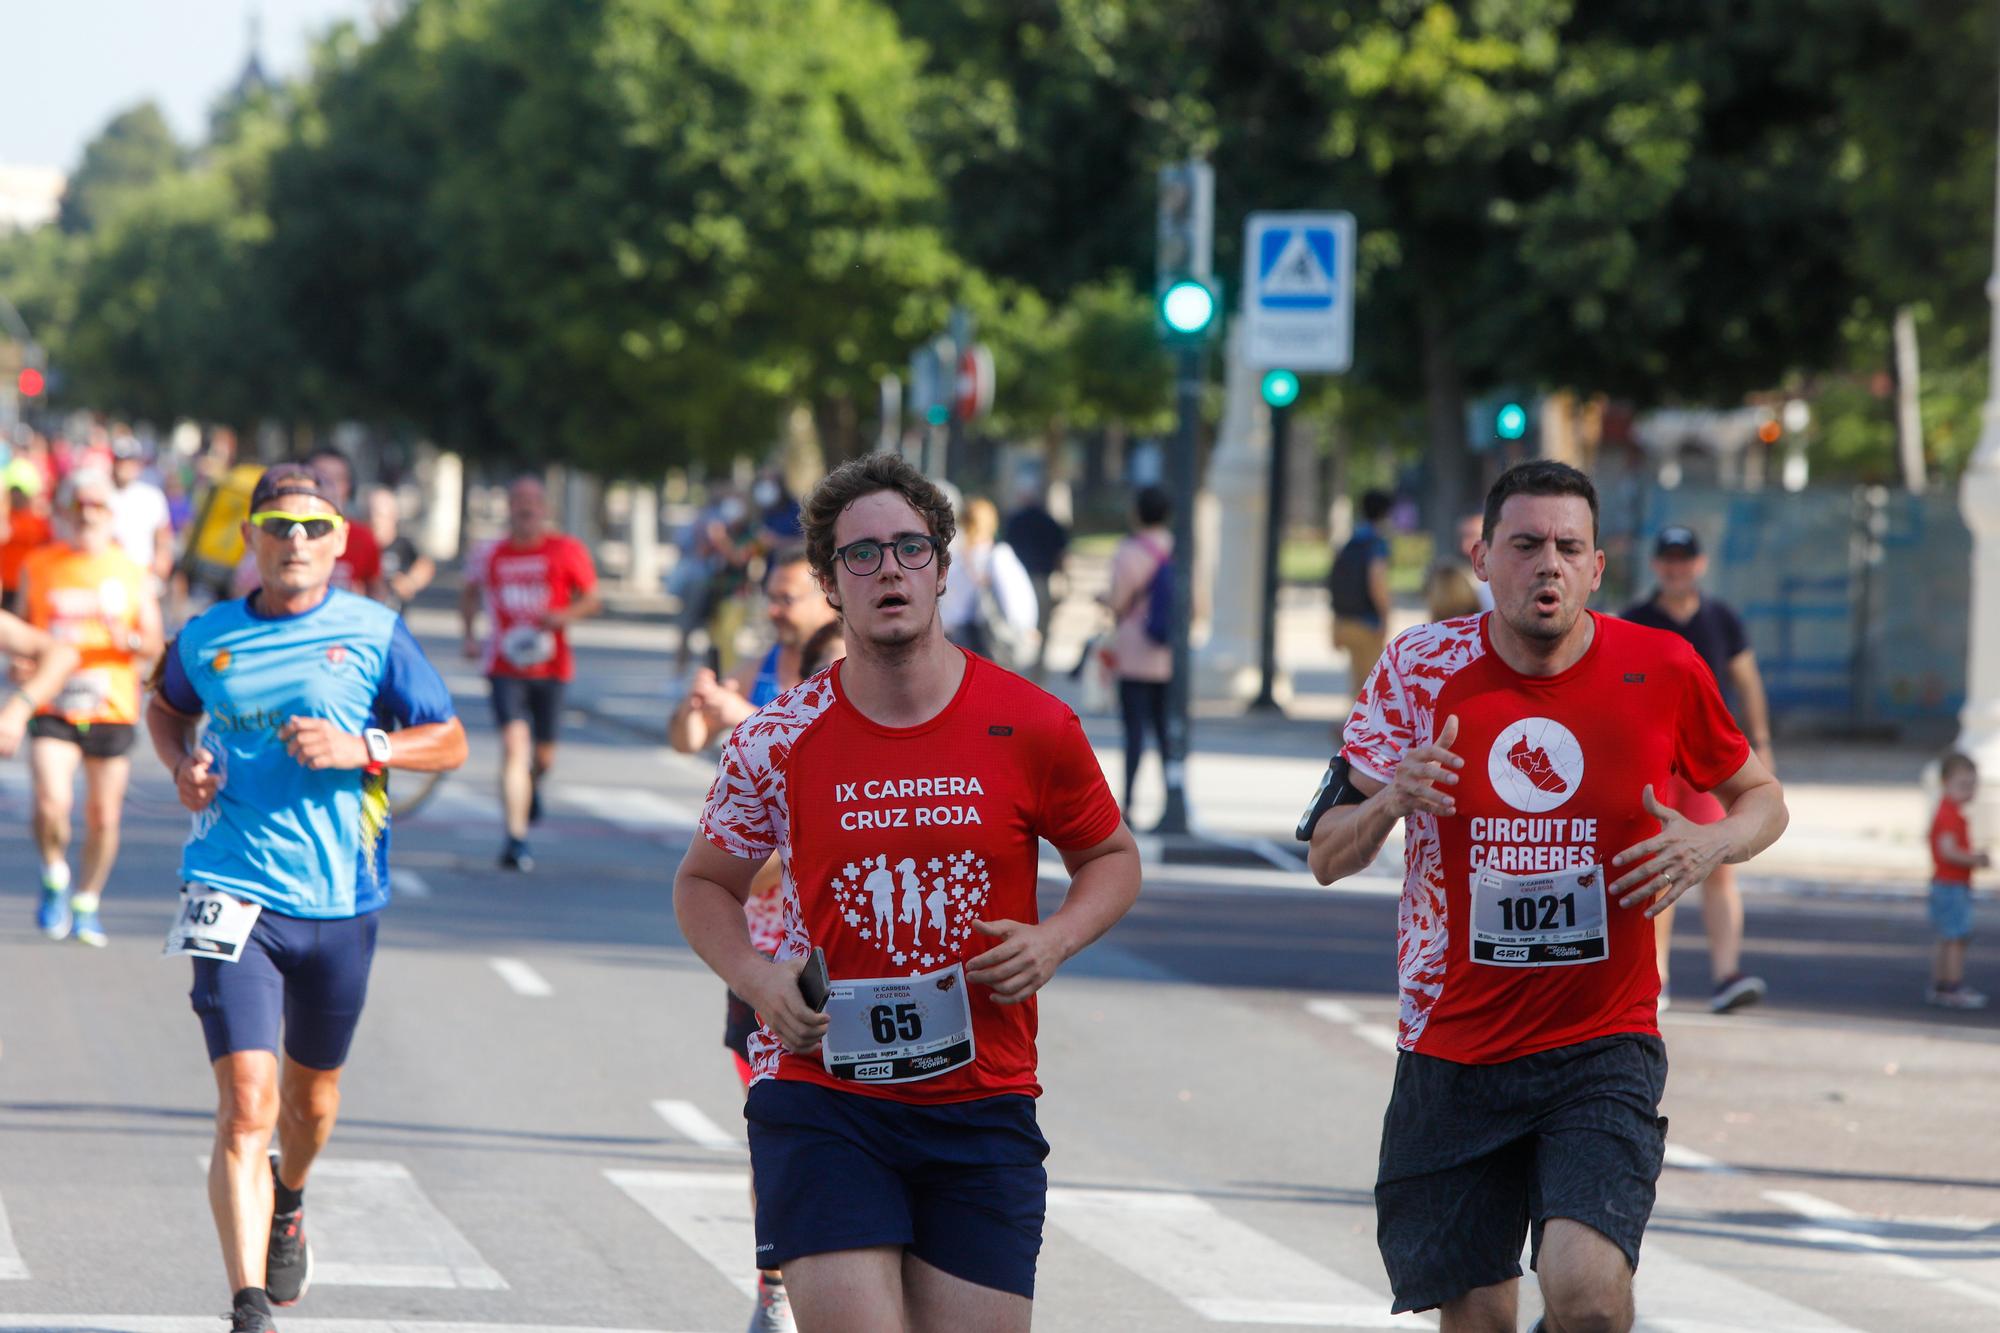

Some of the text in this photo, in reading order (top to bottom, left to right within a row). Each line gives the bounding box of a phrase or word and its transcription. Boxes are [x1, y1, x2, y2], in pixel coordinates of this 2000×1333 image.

[835, 777, 984, 802] IX CARRERA
[840, 806, 982, 831] CRUZ ROJA
[1471, 817, 1598, 842] CIRCUIT DE
[1470, 845, 1596, 870] CARRERES
[1498, 893, 1575, 931] 1021
[870, 1003, 922, 1044] 65
[857, 1065, 889, 1076] 42K
